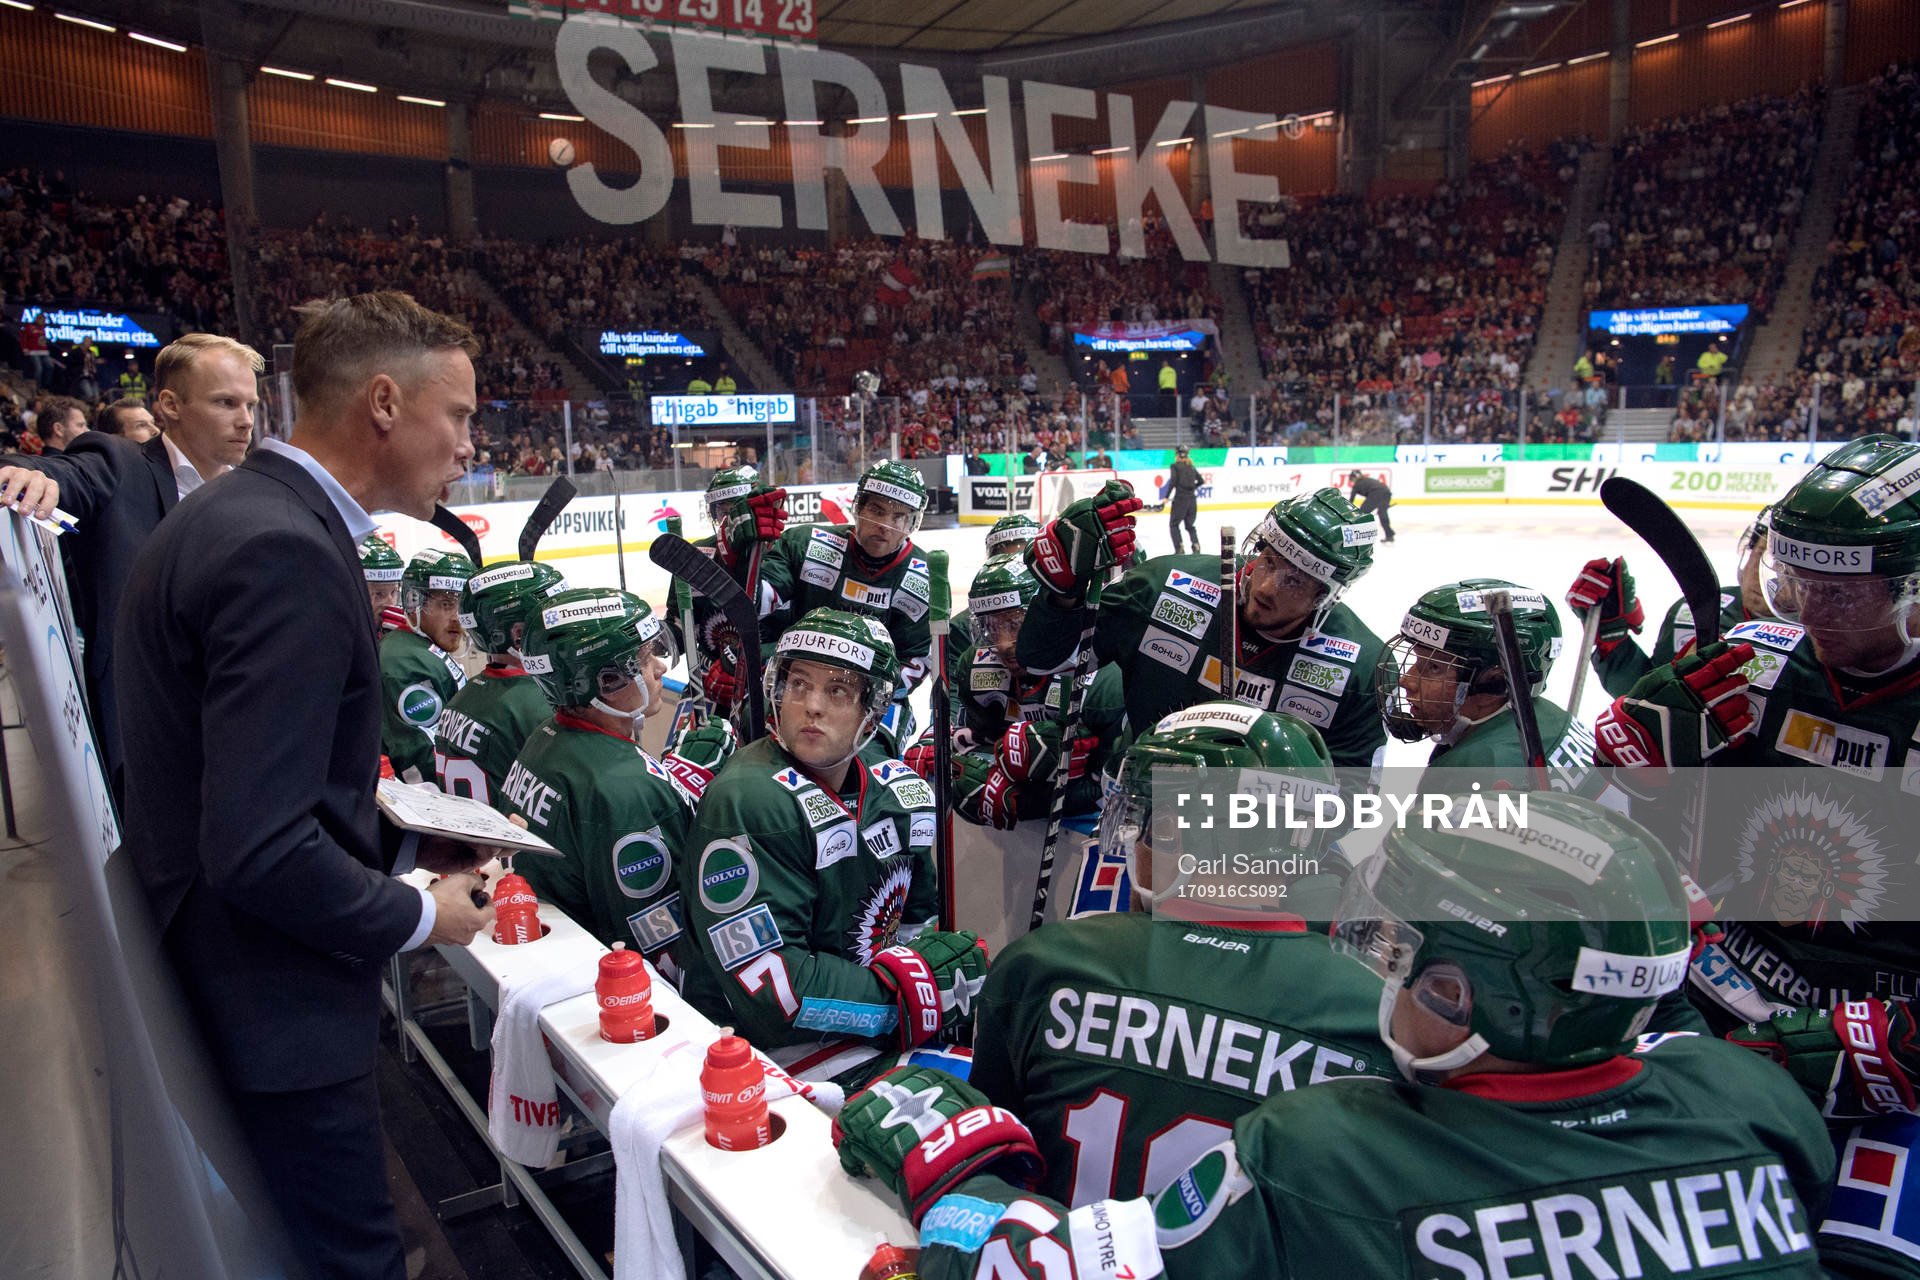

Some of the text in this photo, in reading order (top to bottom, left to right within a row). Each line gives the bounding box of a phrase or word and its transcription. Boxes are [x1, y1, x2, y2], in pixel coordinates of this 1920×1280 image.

[733, 0, 764, 26] 14
[778, 0, 812, 31] 23
[555, 14, 1291, 268] SERNEKE
[79, 311, 124, 327] kunder
[666, 397, 788, 422] higab higab
[1233, 483, 1291, 495] KUMHO TYRE
[1334, 473, 1387, 489] JUA
[1671, 471, 1723, 491] 200
[877, 482, 921, 504] BJURFORS
[543, 510, 626, 536] EPPSVIKEN
[1772, 540, 1862, 567] JURFORS
[481, 567, 533, 585] Tranpenad
[1189, 588, 1217, 603] SPORT
[1191, 580, 1221, 596] INTER
[559, 601, 622, 619] Tranpenad
[1157, 607, 1198, 632] BUDDY
[1160, 599, 1194, 621] CASH
[1753, 631, 1792, 647] SPORT
[1759, 624, 1800, 639] INTER
[791, 633, 868, 662] BJURFORS
[1151, 642, 1184, 664] BOHUS
[1324, 645, 1354, 659] SPORT
[1326, 637, 1358, 652] INTER
[1292, 668, 1333, 689] BUDDY
[1296, 660, 1328, 678] CASH
[406, 698, 434, 714] VOLVO
[1288, 700, 1322, 719] BOHUS
[436, 708, 485, 755] ERNEKE
[501, 759, 557, 827] RNEKE
[911, 829, 934, 838] BOHUS
[826, 839, 847, 857] BOHUS
[618, 854, 662, 877] VOLVO
[703, 866, 746, 887] VOLVO
[1694, 944, 1753, 992] KF
[737, 951, 799, 1018] 7
[1044, 987, 1354, 1097] SERNEKE
[1415, 1162, 1812, 1280] SERNEKE
[1090, 1201, 1117, 1271] UMHO TYRE
